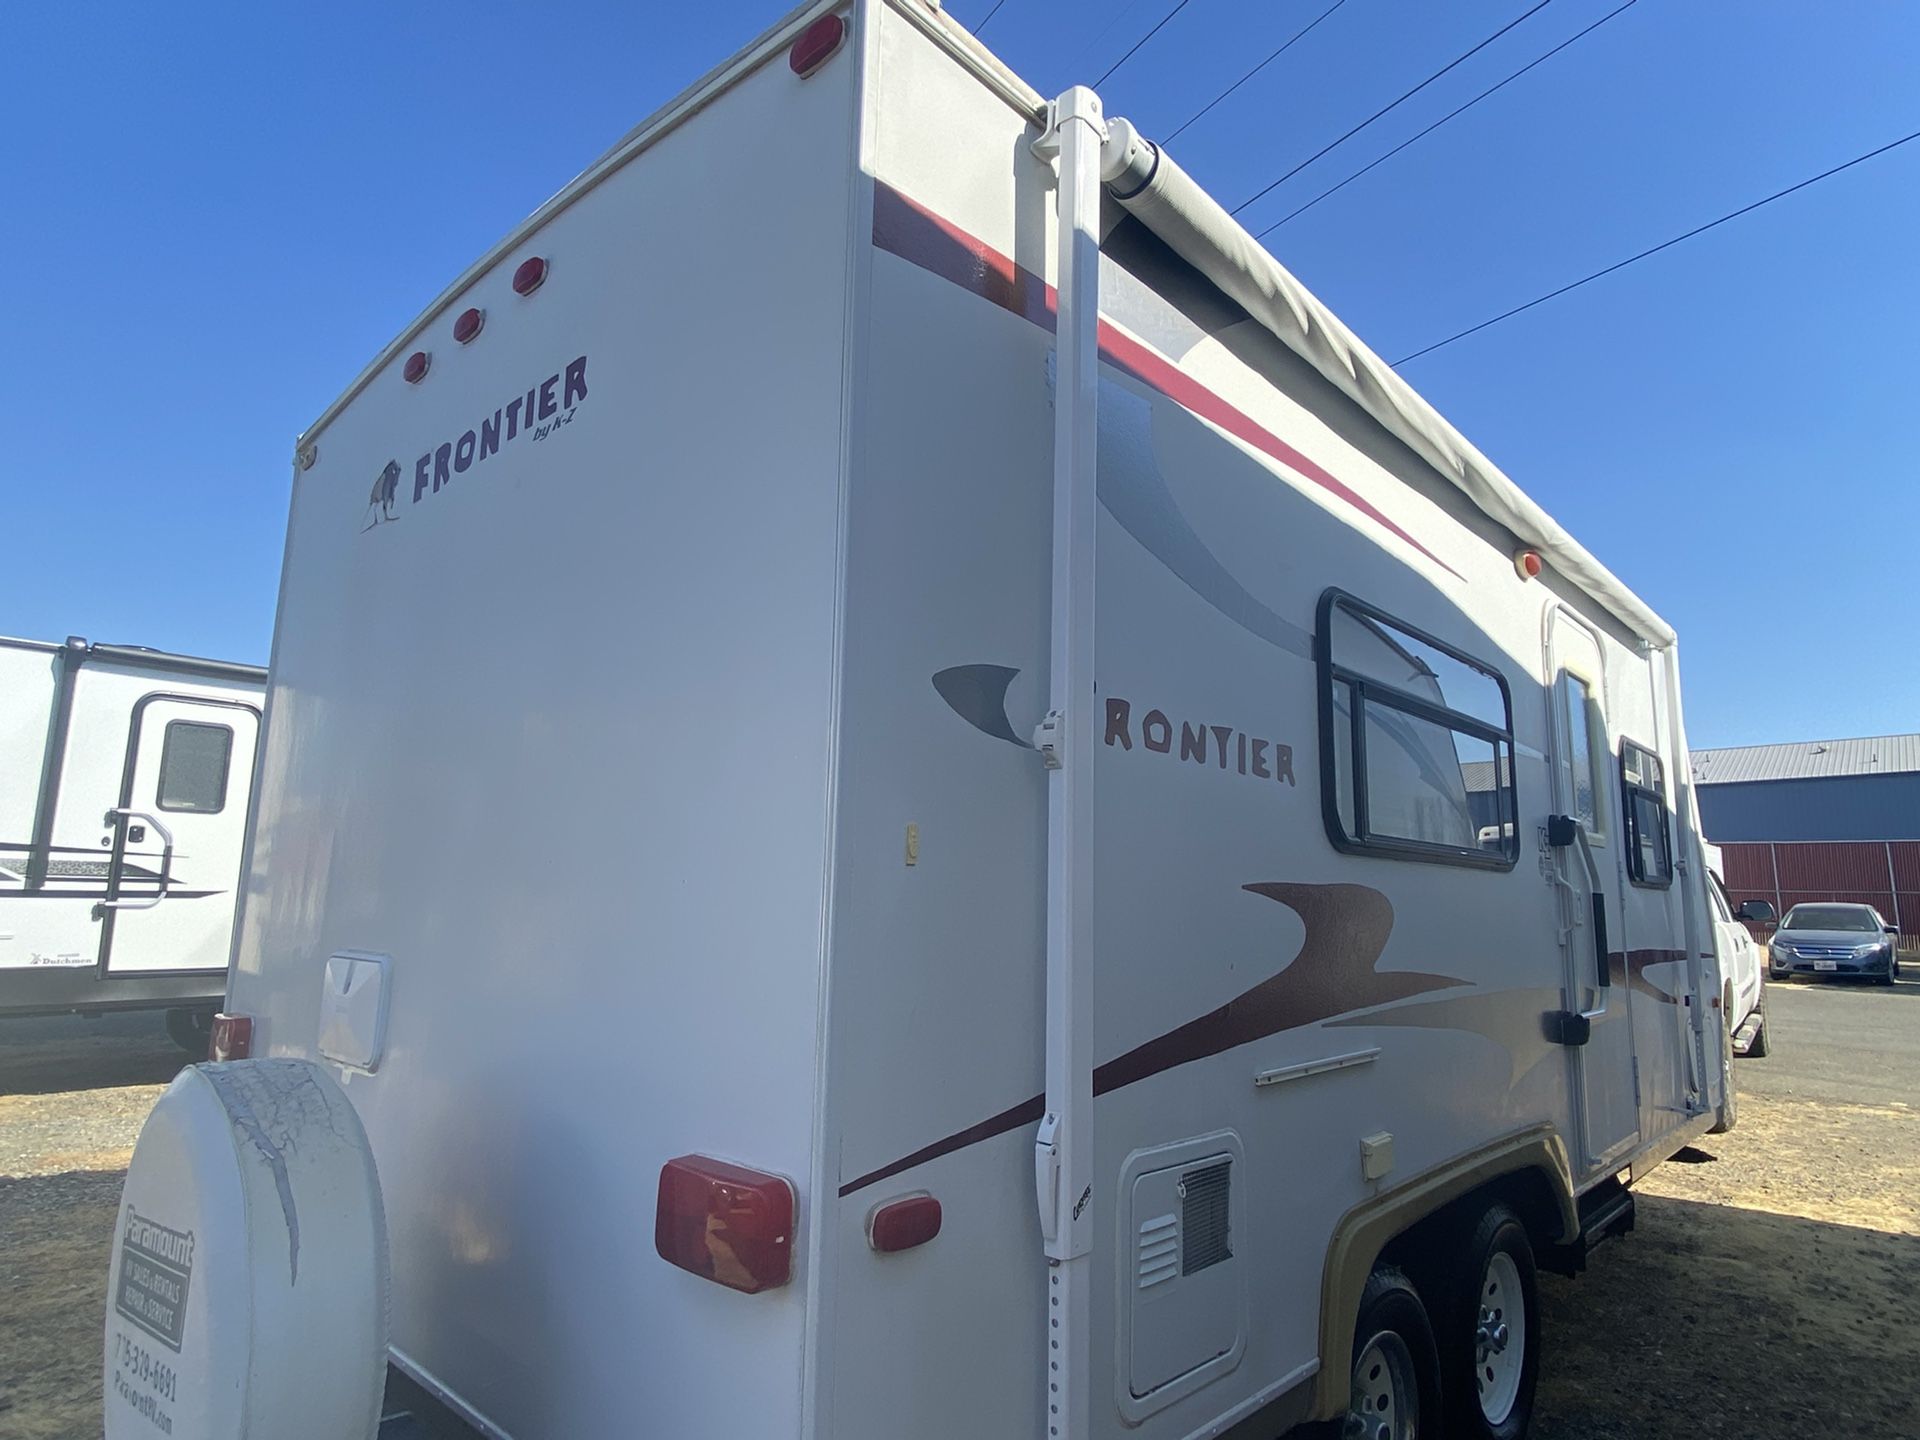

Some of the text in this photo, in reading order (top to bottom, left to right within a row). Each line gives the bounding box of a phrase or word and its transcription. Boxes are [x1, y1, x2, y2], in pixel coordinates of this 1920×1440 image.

[413, 355, 588, 504] FRONTIER
[532, 423, 551, 441] by
[1094, 680, 1296, 788] RONTIER
[42, 957, 92, 965] Dutchmen
[125, 1207, 193, 1267] Paramount
